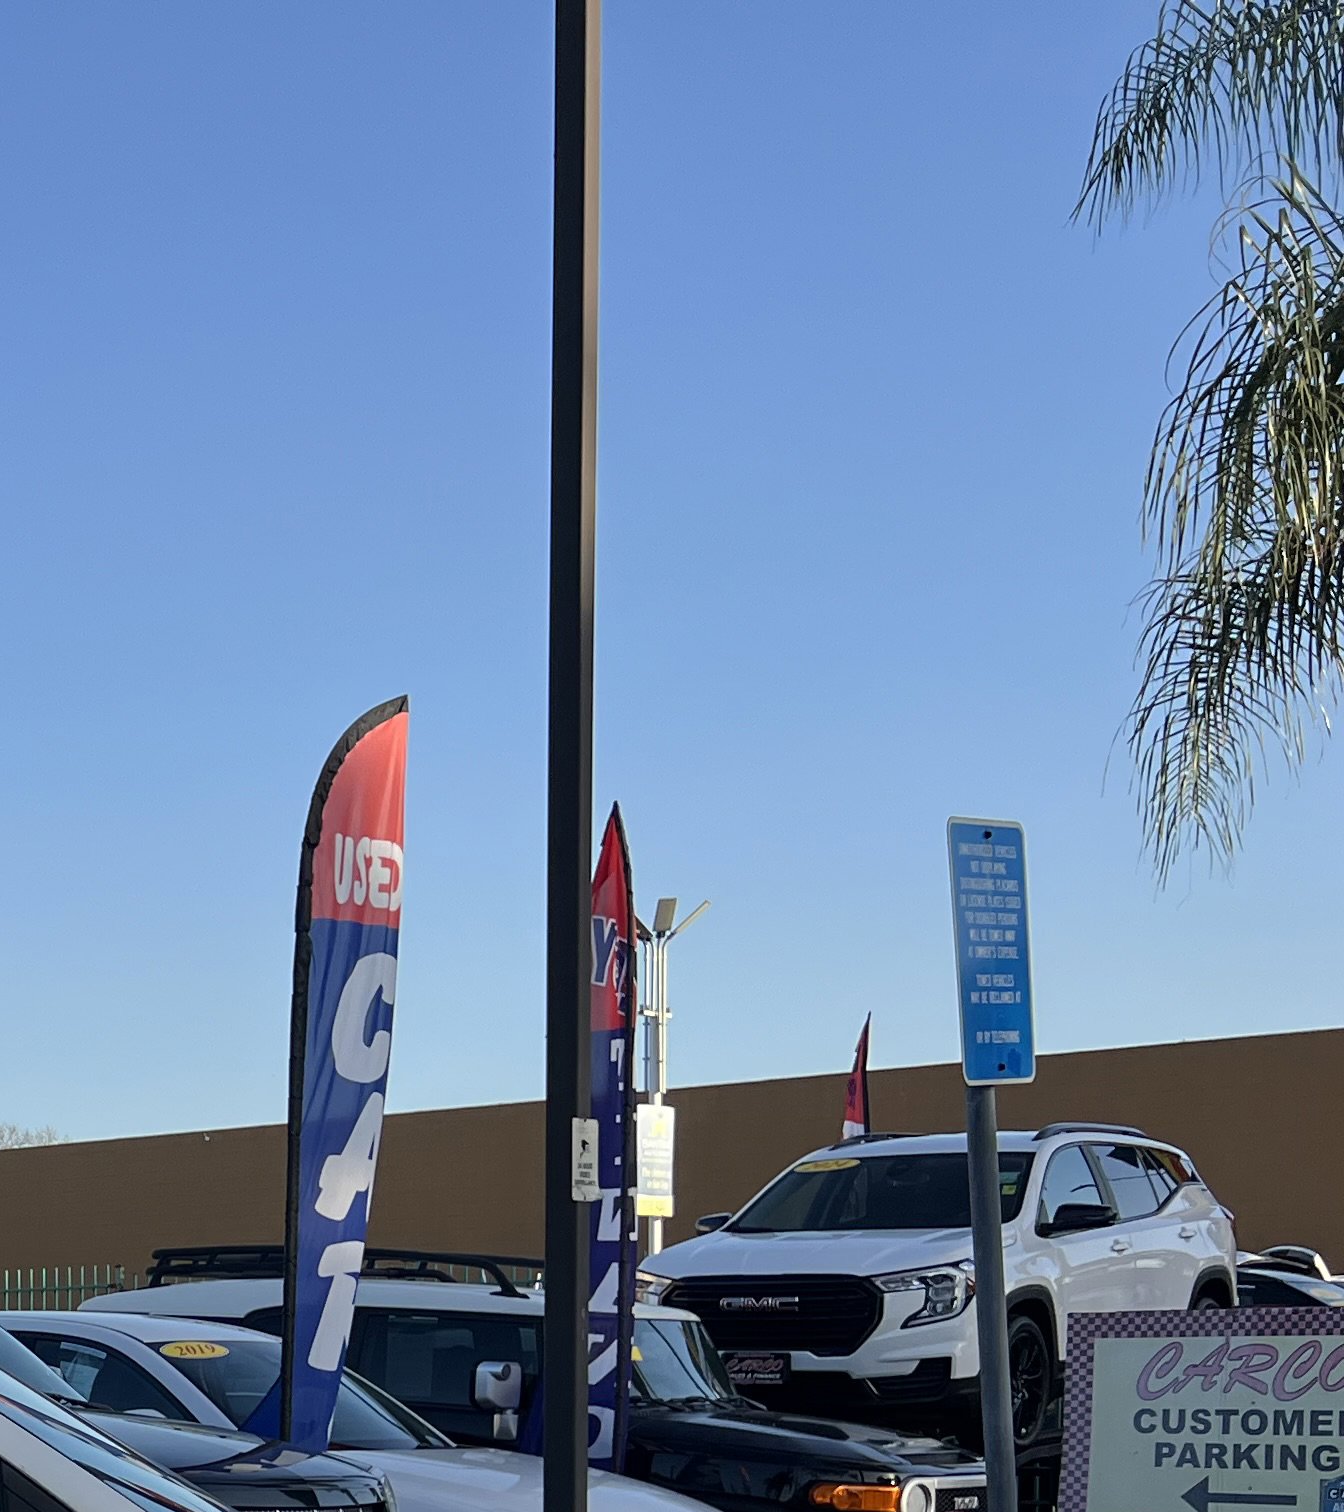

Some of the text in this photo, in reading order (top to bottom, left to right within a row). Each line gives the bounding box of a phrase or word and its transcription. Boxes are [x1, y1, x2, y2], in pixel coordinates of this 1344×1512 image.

[334, 832, 404, 912] USED
[719, 1296, 800, 1313] GMC
[174, 1343, 216, 1357] 2019
[1132, 1408, 1344, 1437] CUSTOME
[1153, 1441, 1340, 1472] PARKING
